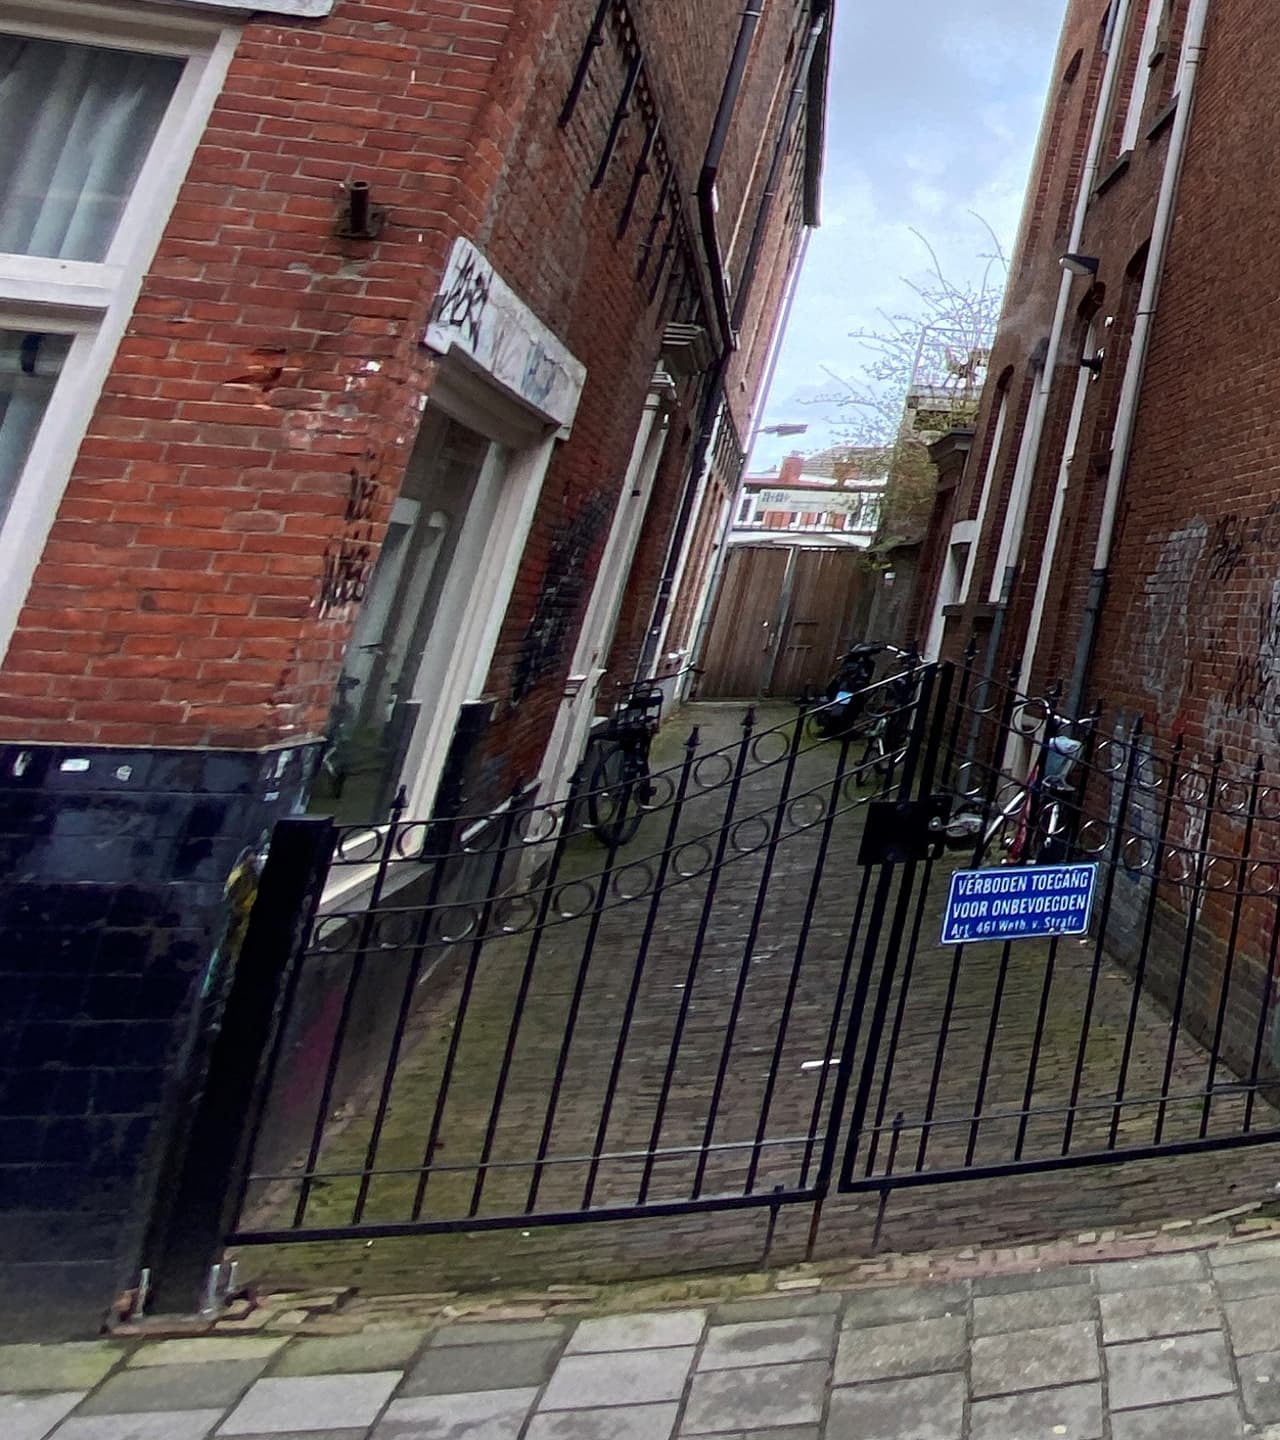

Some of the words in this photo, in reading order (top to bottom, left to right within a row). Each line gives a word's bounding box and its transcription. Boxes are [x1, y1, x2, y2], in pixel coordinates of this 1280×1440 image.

[958, 875, 1027, 896] VERBODEN
[1031, 871, 1089, 891] TOEGANG
[952, 900, 988, 919] VOOR
[991, 894, 1087, 916] ONBEVOEGDEN
[976, 920, 996, 934] 461
